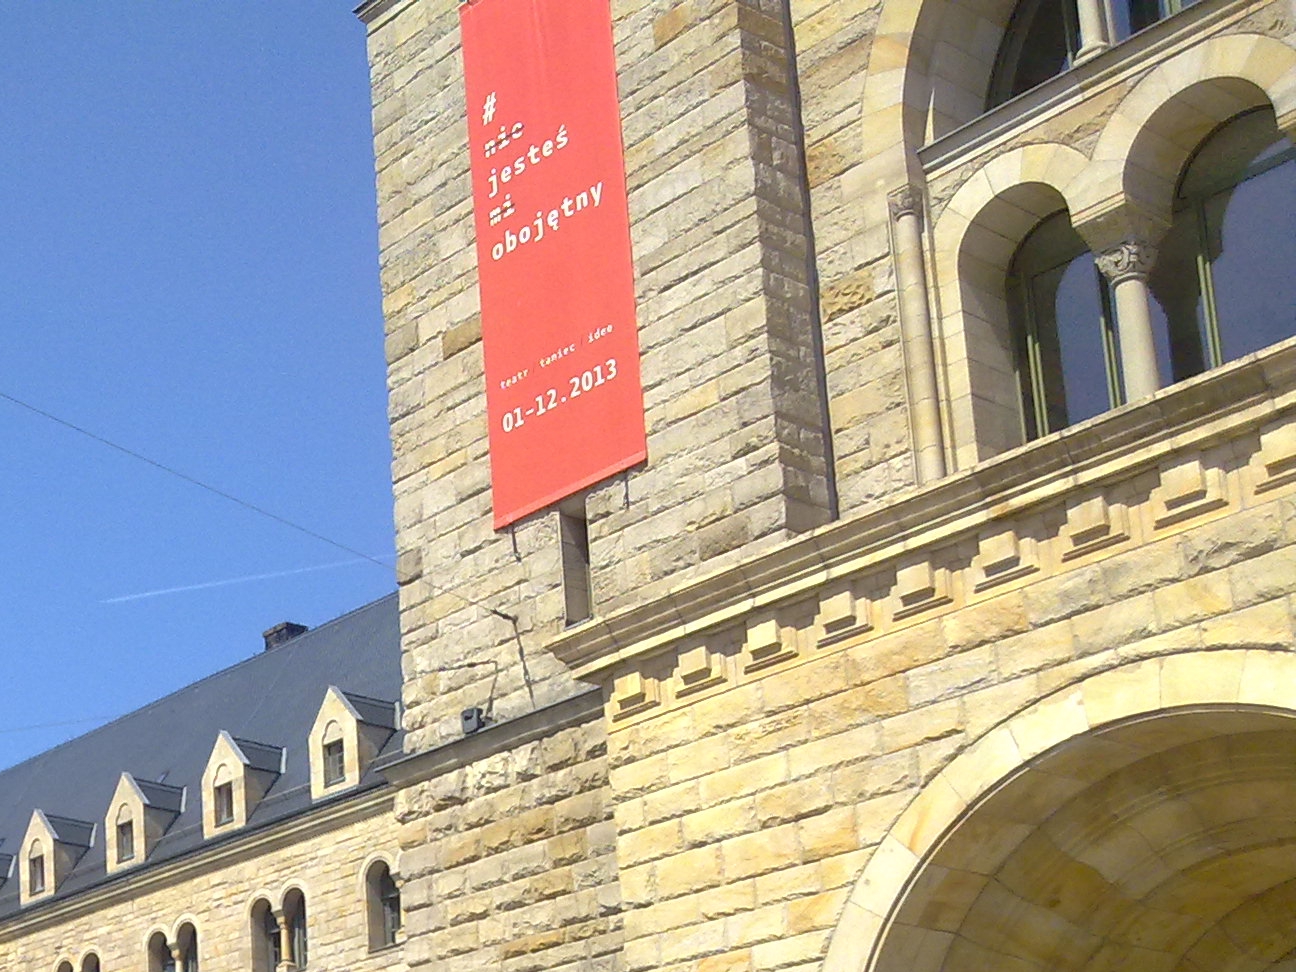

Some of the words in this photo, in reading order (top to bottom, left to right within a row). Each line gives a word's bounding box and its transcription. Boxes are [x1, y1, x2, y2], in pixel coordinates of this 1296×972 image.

[481, 91, 497, 126] #
[487, 124, 570, 199] jesteś
[491, 181, 603, 261] obojętny
[501, 358, 618, 433] 01-12.2013
